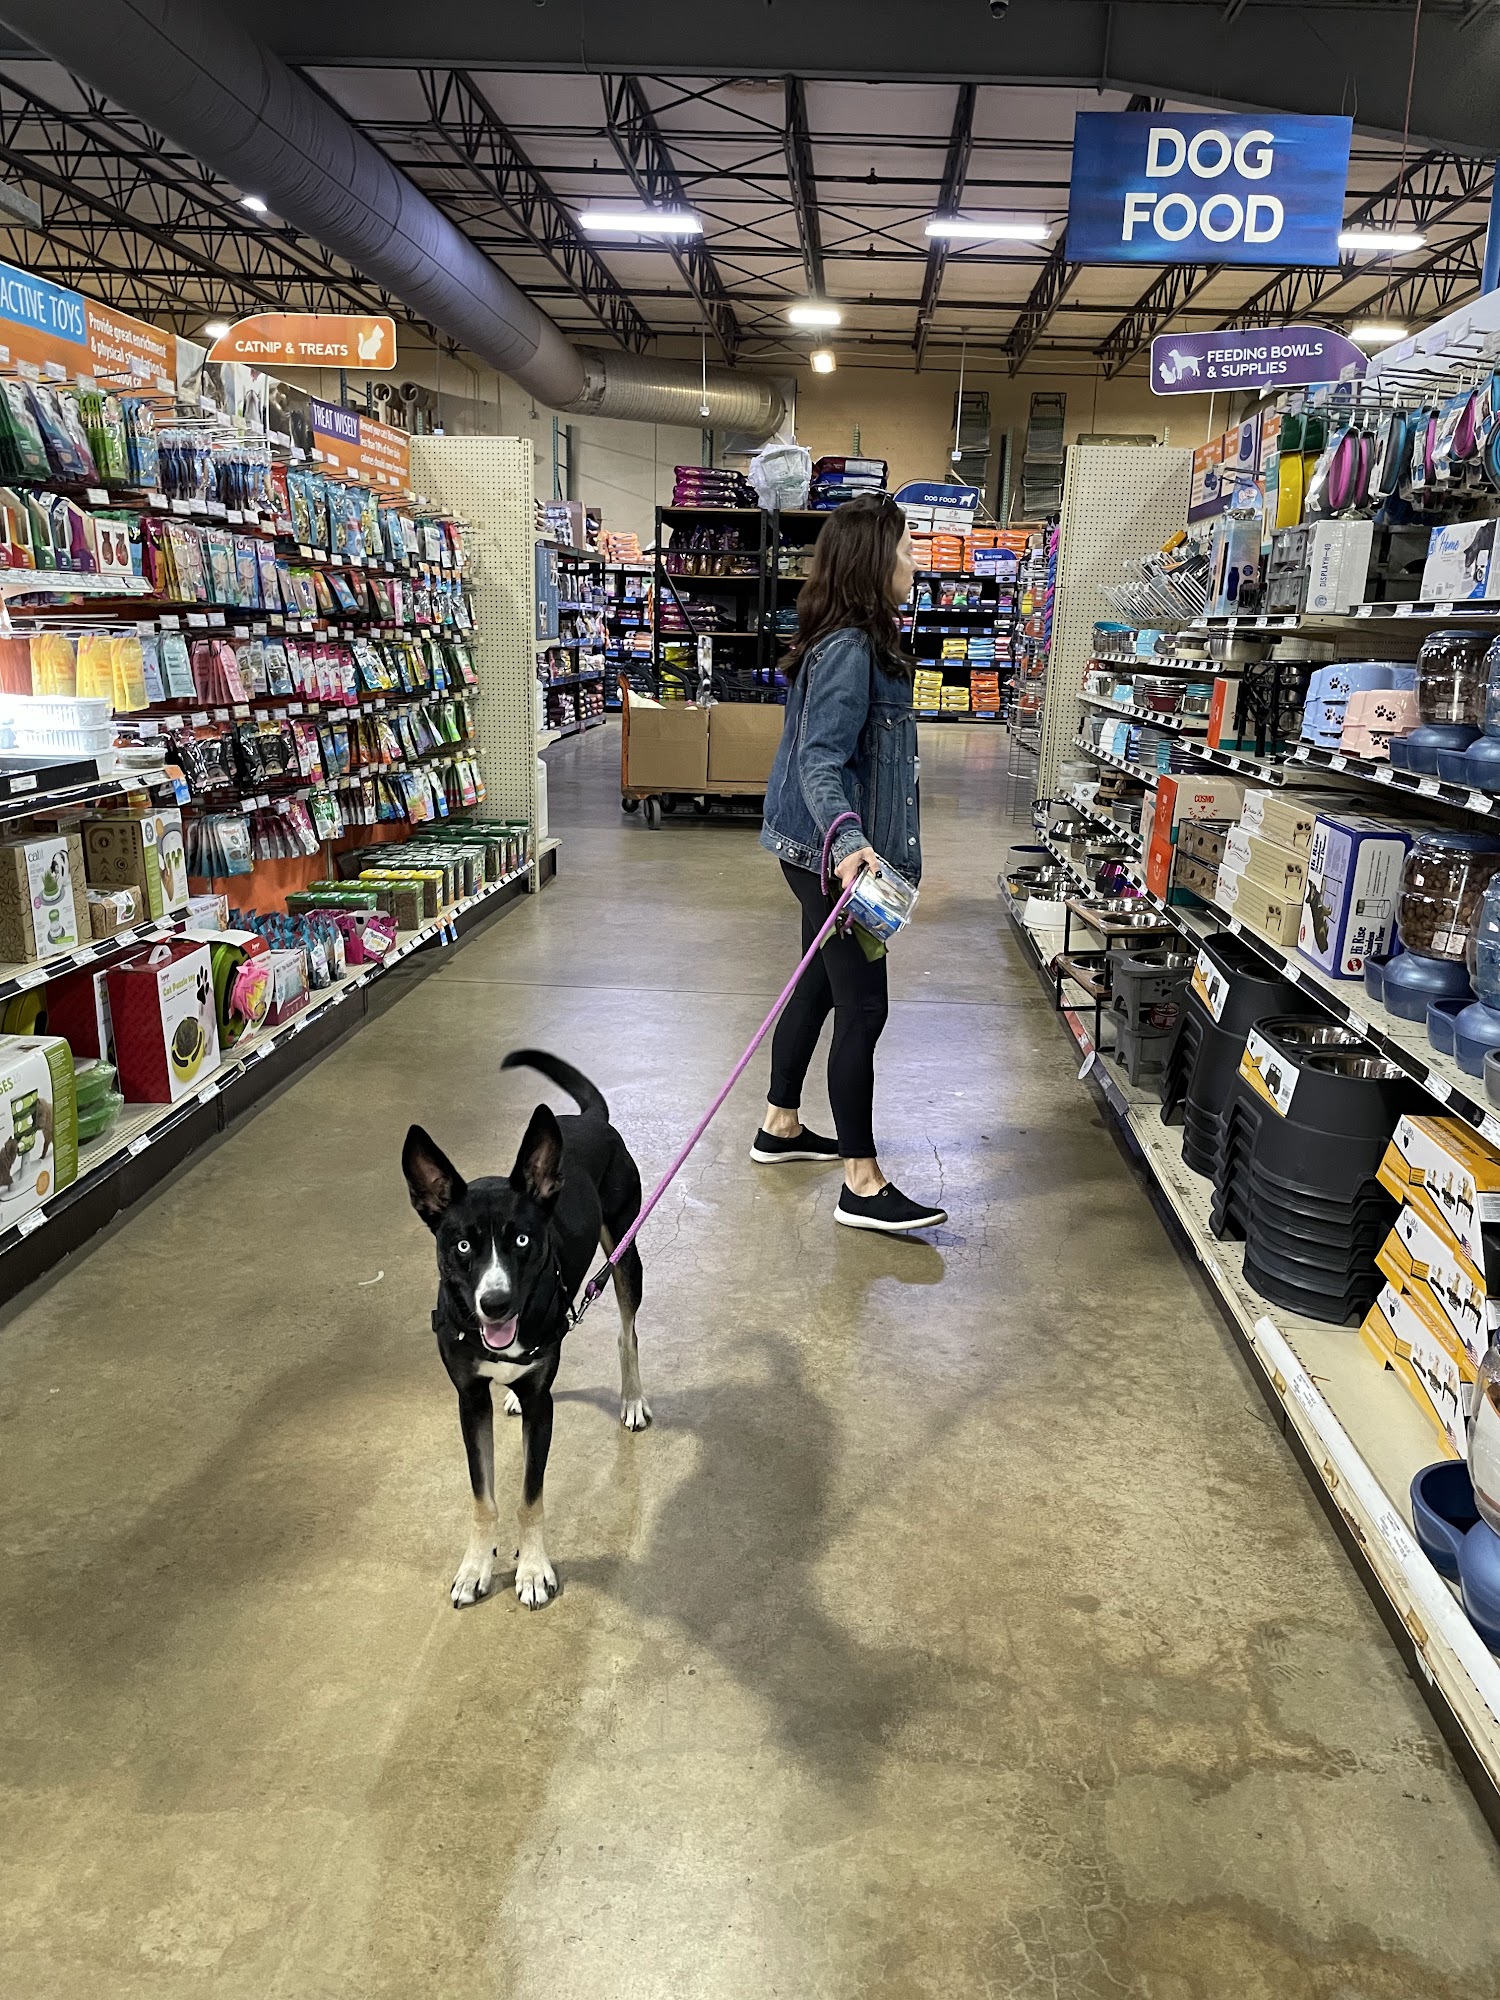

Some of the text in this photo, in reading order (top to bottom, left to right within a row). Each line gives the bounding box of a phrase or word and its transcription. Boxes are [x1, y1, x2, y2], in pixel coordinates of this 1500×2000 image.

[1145, 127, 1275, 180] DOG
[1121, 192, 1284, 243] FOOD
[49, 295, 83, 336] TOYS
[89, 312, 113, 337] Provide
[114, 327, 133, 343] great
[91, 336, 96, 353] &
[97, 339, 124, 362] physical
[235, 341, 348, 356] CATNIP & TREATS
[1206, 343, 1323, 364] FEEDING BOWLS
[1206, 361, 1287, 378] & SUPPLIES
[313, 402, 357, 438] TREAT WISELY
[1194, 795, 1215, 804] COSMO
[1351, 926, 1367, 955] Hi Rise
[1363, 931, 1375, 956] Stainless
[1376, 925, 1386, 941] Diner
[163, 986, 171, 997] Cat
